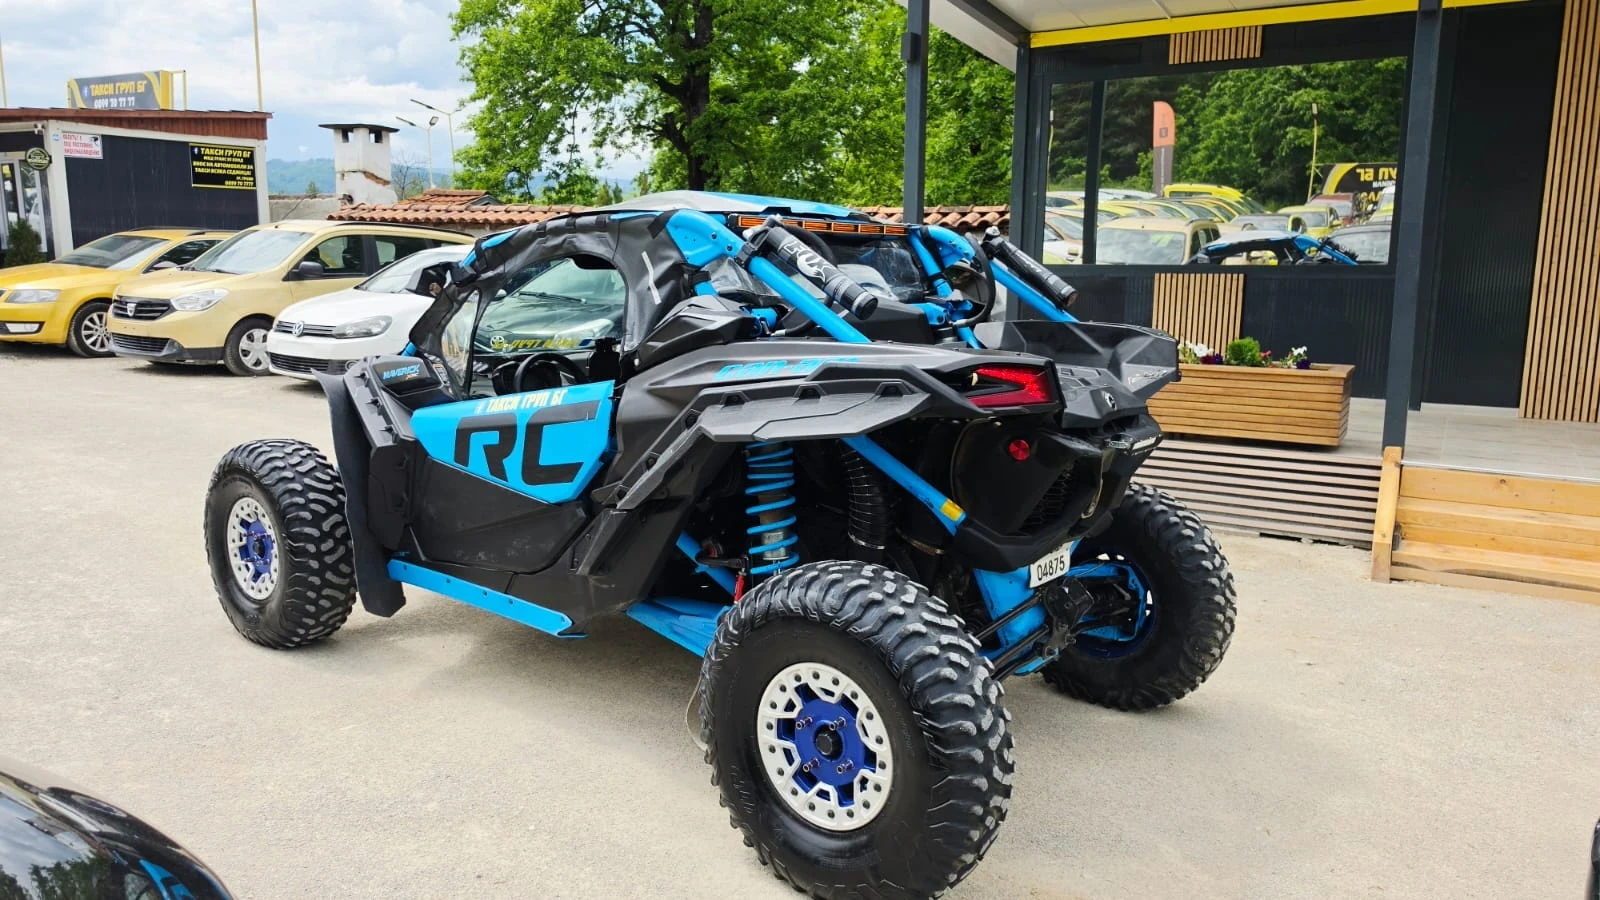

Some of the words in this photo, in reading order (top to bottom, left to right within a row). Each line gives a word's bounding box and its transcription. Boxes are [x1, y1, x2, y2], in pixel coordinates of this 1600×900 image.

[90, 83, 114, 97] ТАКСИ
[115, 81, 135, 94] ГРУП
[136, 80, 147, 93] БГ
[200, 147, 224, 156] ТАКСИ
[224, 149, 242, 157] ГРУП
[243, 150, 251, 158] БГ
[383, 363, 421, 380] MAVERICK
[486, 395, 522, 413] ТАКСИ
[521, 391, 552, 409] ГРУП
[551, 389, 569, 406] БГ
[453, 399, 601, 486] RC
[1036, 554, 1066, 581] 04875
